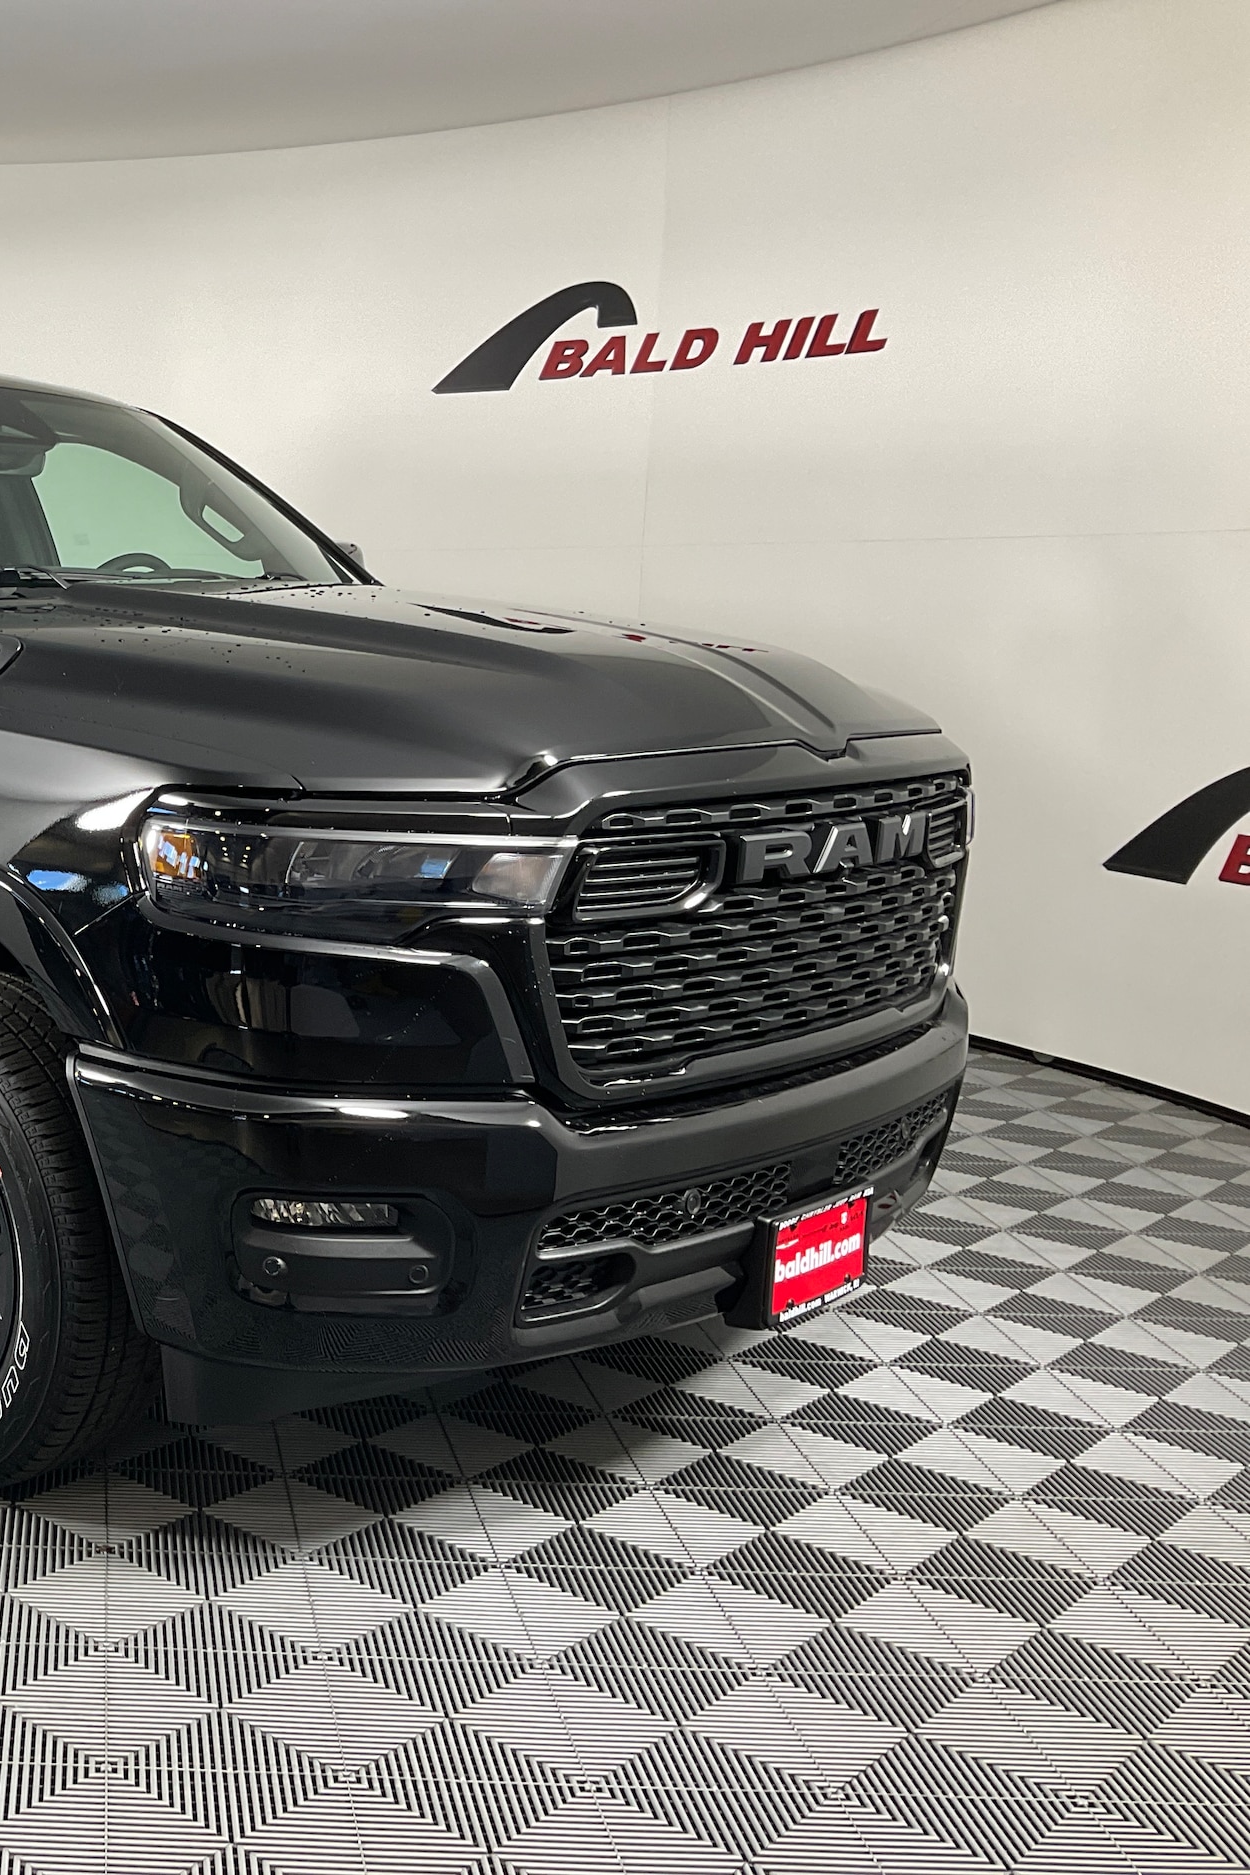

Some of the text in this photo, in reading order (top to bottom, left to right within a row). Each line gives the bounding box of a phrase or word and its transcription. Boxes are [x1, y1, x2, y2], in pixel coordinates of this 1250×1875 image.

[538, 308, 890, 381] BALD HILL
[736, 810, 932, 885] RAM
[774, 1231, 861, 1284] baldhill.com
